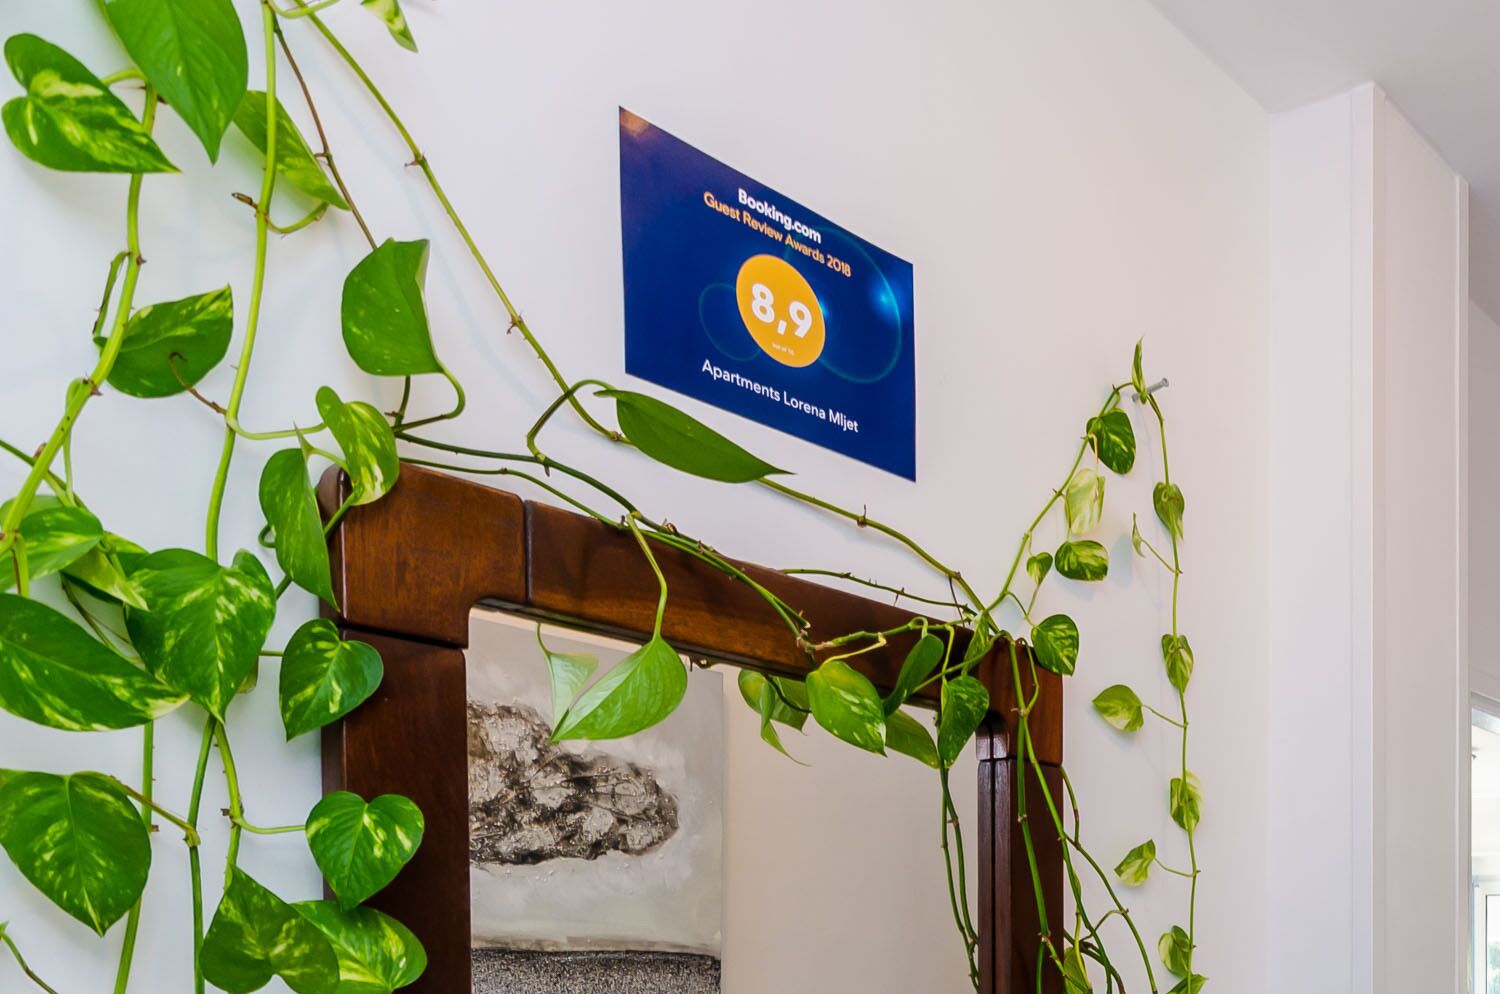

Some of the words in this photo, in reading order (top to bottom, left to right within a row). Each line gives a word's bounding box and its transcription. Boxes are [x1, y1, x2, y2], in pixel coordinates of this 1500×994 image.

[703, 191, 741, 222] Guest
[742, 210, 783, 243] Review
[784, 233, 825, 265] Awards
[826, 254, 852, 278] 2018
[738, 187, 822, 244] Booking.com
[751, 283, 812, 338] 8,9
[701, 359, 781, 402] Apartments
[783, 390, 826, 420] Lorena
[828, 408, 859, 433] Mljet
